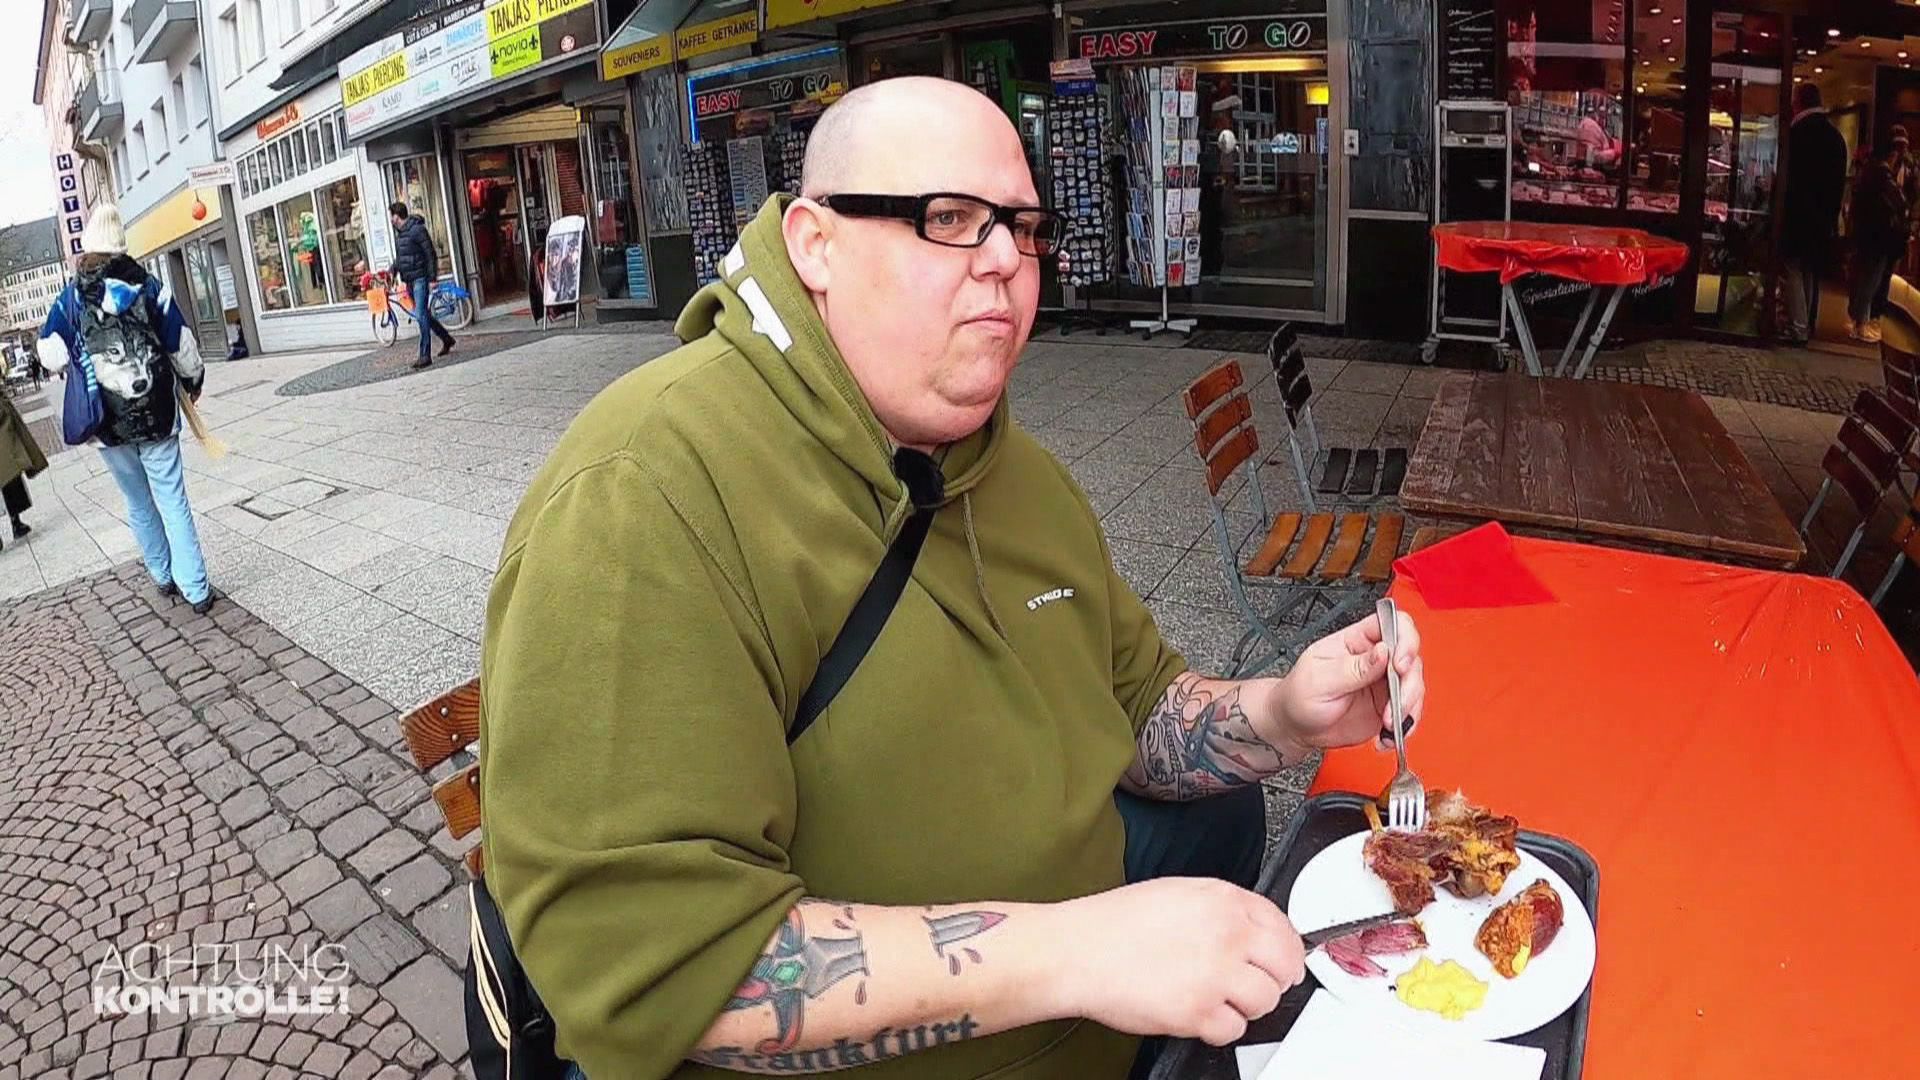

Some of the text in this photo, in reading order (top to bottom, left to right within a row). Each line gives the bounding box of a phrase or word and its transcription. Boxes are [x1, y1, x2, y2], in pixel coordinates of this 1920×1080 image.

[499, 38, 529, 57] novia
[612, 46, 660, 69] SOUVENIERS
[678, 31, 707, 49] KAFFEE
[1080, 21, 1311, 58] EASY TO GO
[373, 54, 405, 91] PIERCING
[696, 72, 831, 115] EASY TO GO
[60, 154, 84, 254] HOTEL
